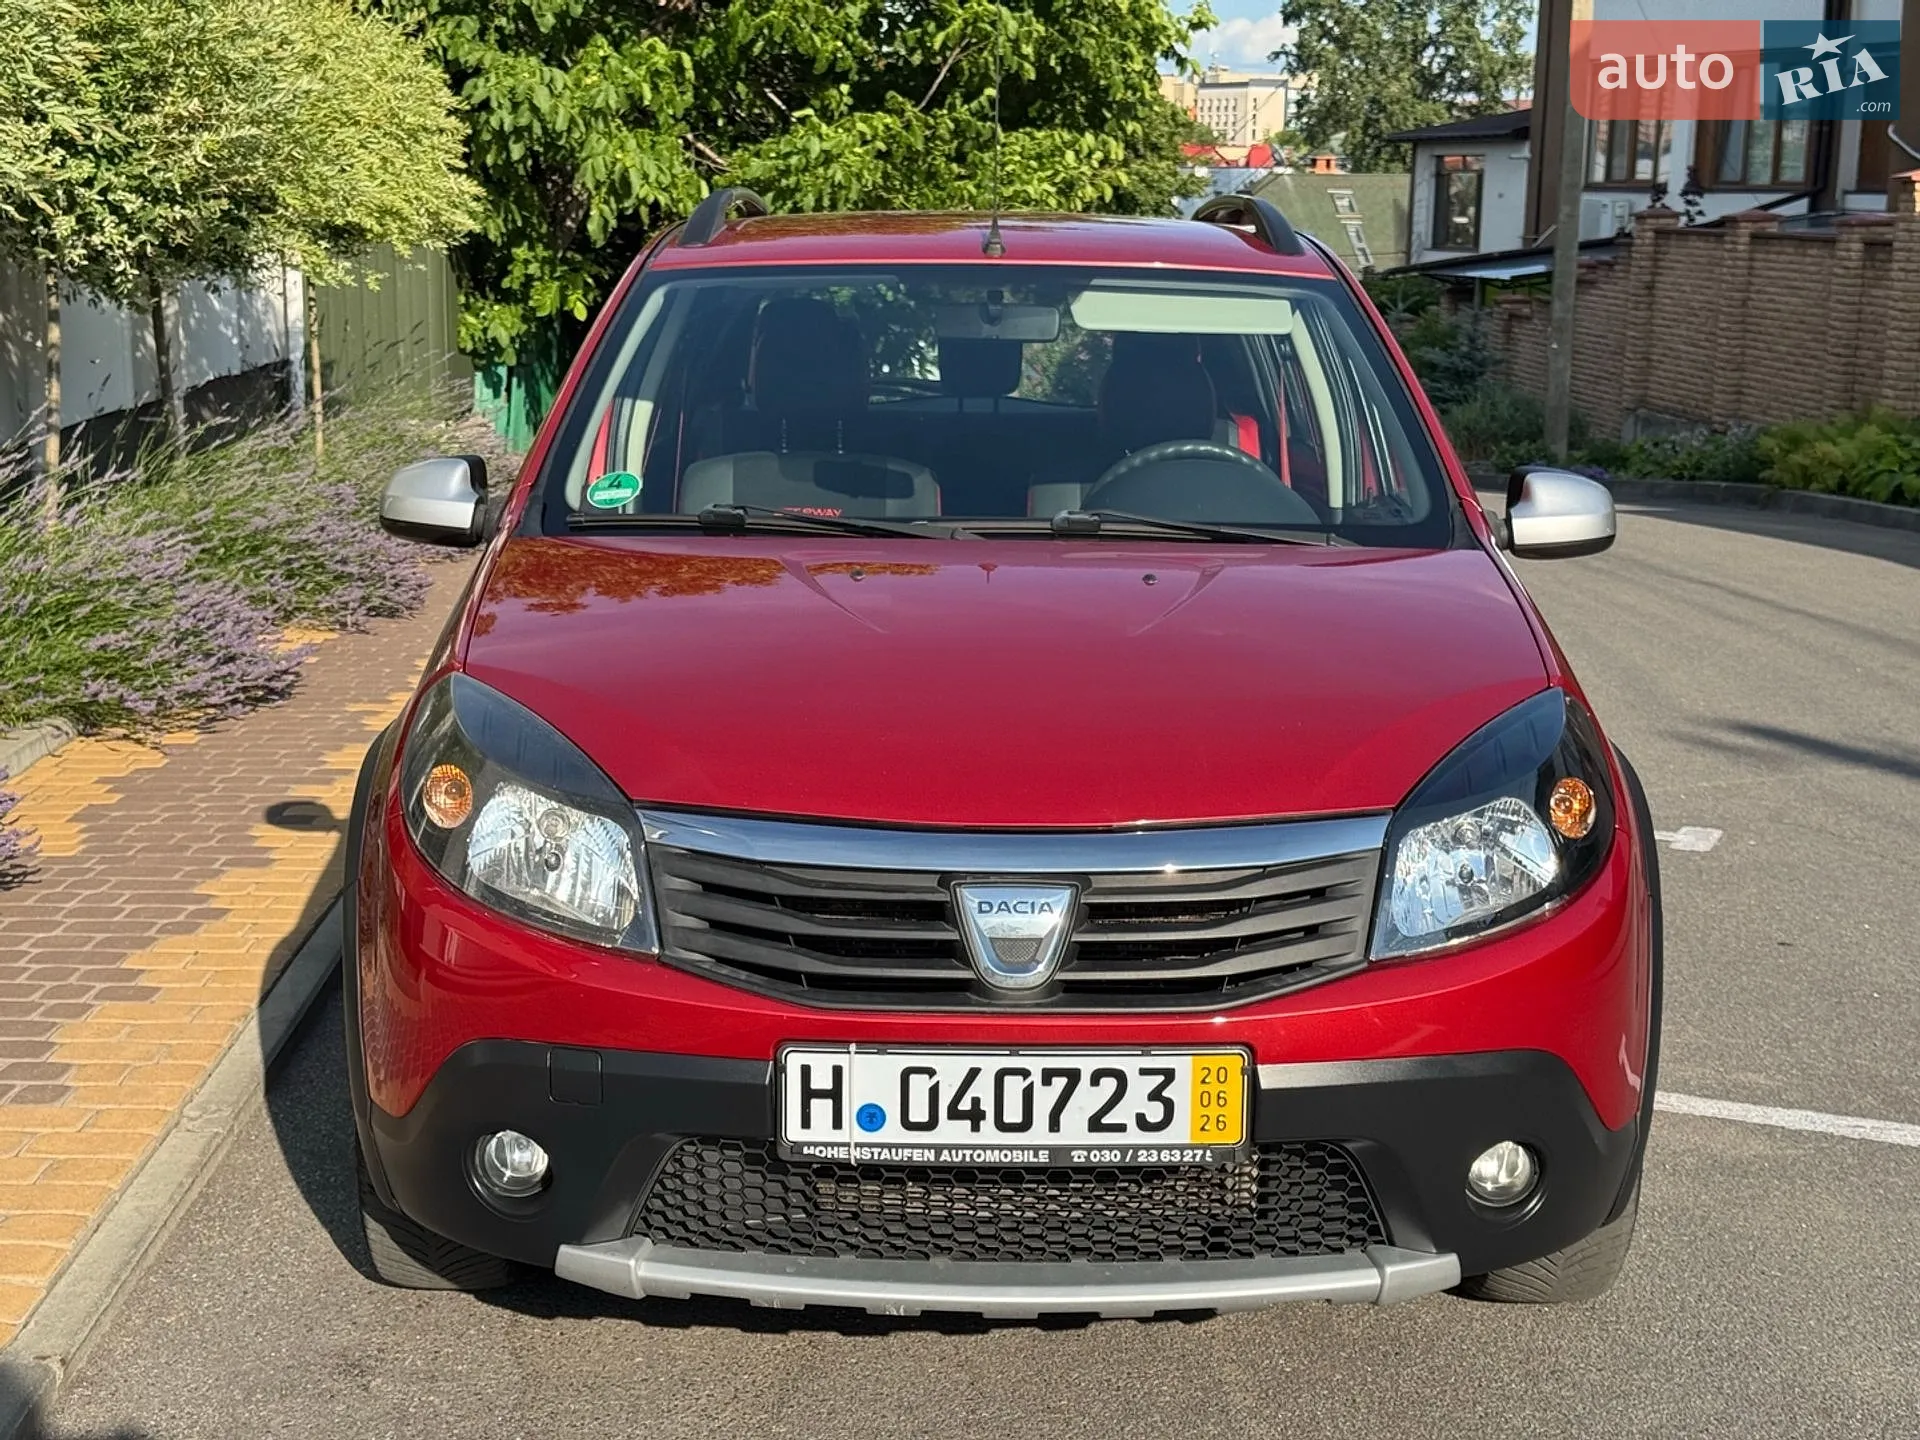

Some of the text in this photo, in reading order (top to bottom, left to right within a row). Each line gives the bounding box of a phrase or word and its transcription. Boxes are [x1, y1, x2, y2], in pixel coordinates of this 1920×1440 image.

[608, 474, 622, 489] 4
[977, 901, 1054, 914] DACIA
[1200, 1066, 1228, 1084] 20
[801, 1064, 1176, 1133] H 040723
[1200, 1090, 1227, 1108] 06
[1200, 1114, 1227, 1132] 26
[803, 1146, 935, 1161] HOHENSTAUFEN
[940, 1149, 1049, 1162] AUTOMOBILE
[1090, 1149, 1121, 1162] 030
